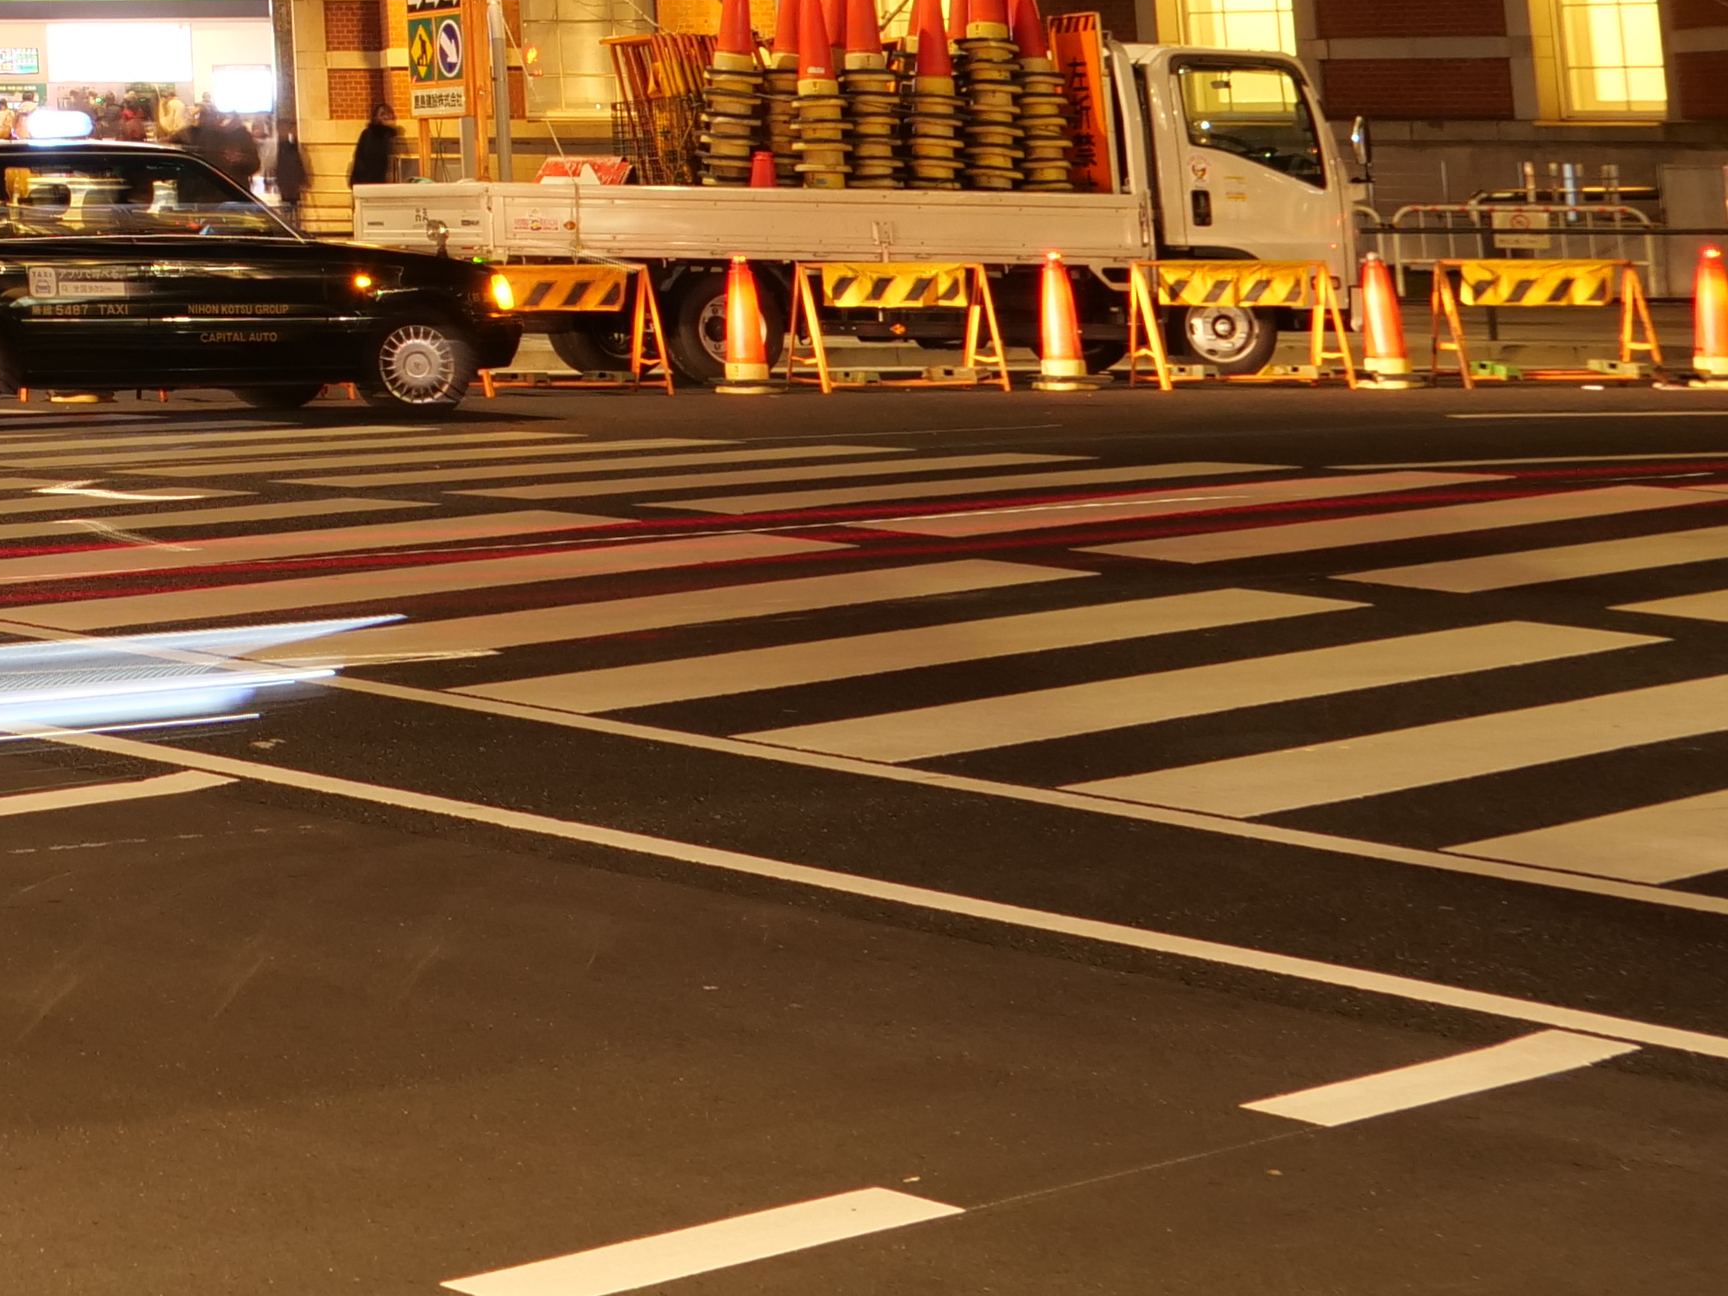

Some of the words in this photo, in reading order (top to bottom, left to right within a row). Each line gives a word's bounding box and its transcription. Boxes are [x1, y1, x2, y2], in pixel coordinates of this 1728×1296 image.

[97, 304, 129, 315] TAXI
[187, 304, 219, 315] NIHON
[221, 304, 253, 315] KOTSU
[255, 304, 289, 315] GROUP
[200, 332, 246, 343] CAPITAL
[248, 332, 278, 343] AUTO
